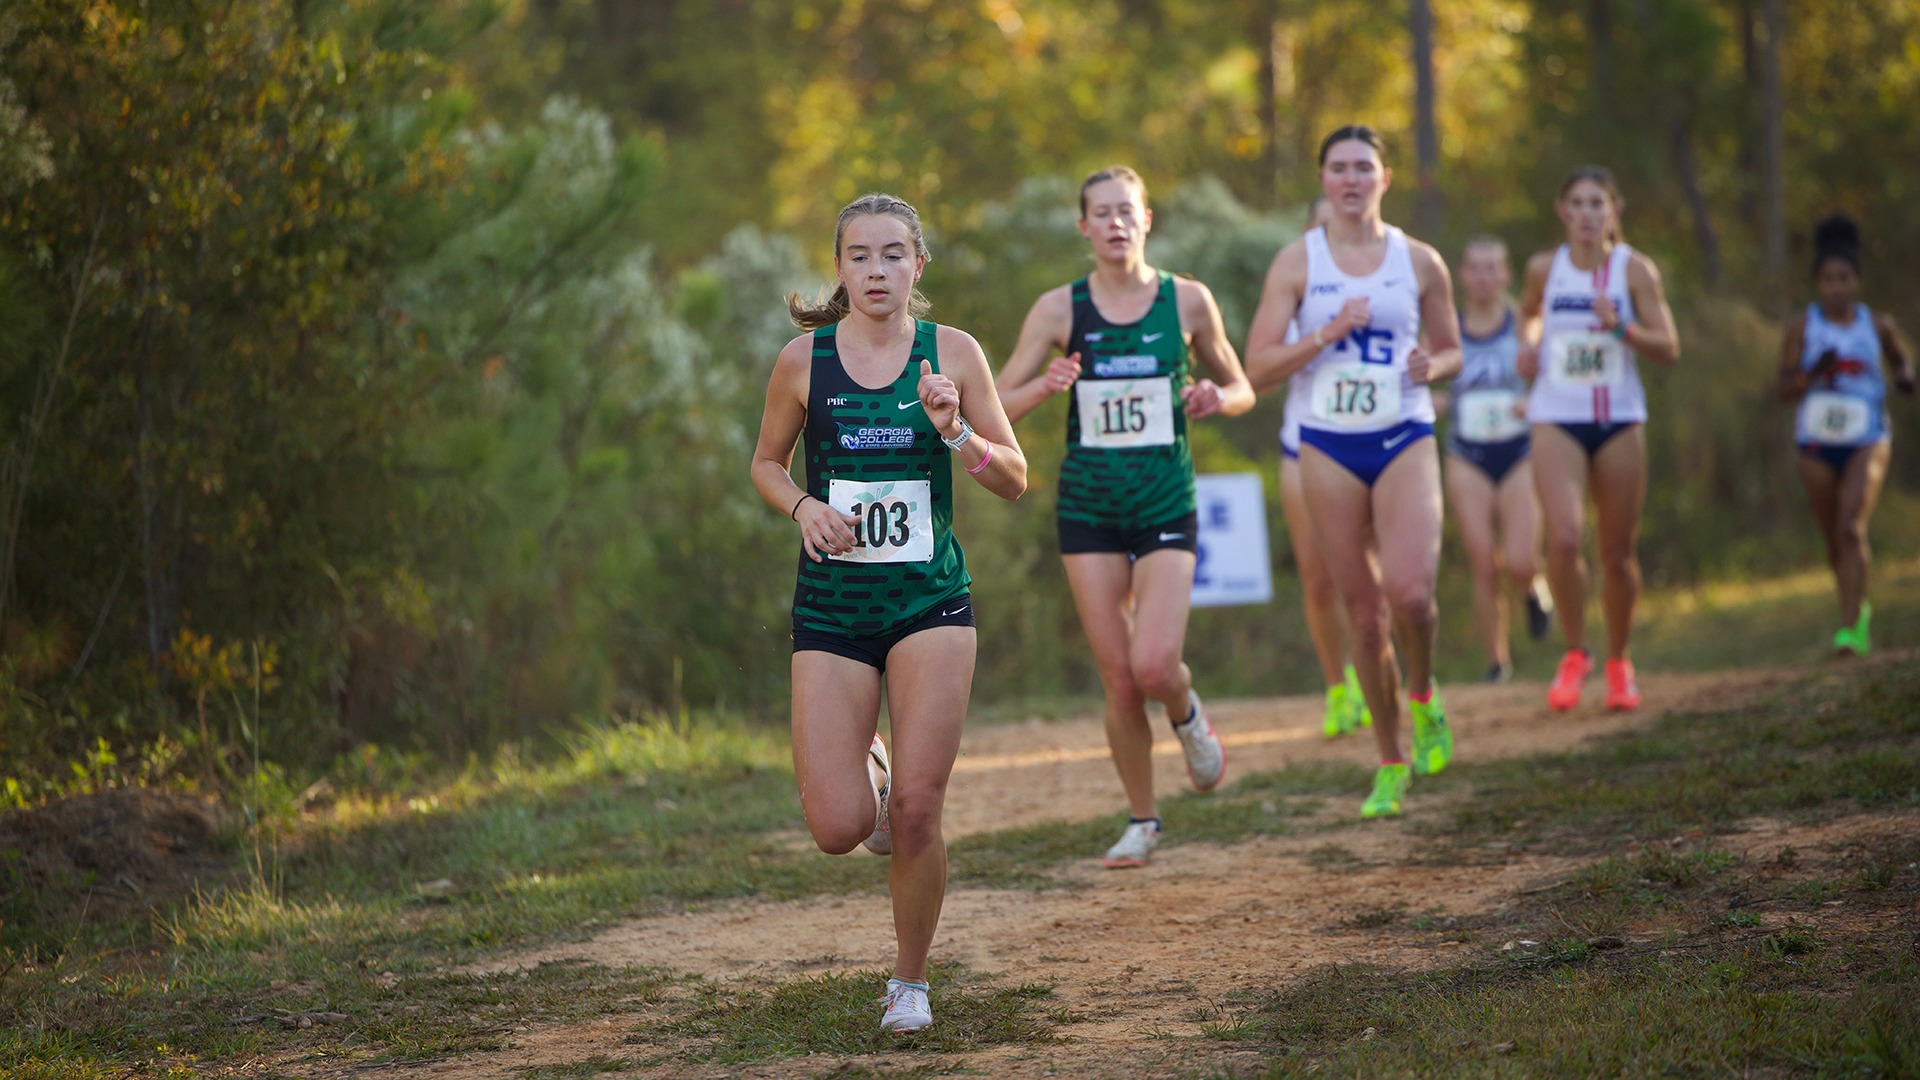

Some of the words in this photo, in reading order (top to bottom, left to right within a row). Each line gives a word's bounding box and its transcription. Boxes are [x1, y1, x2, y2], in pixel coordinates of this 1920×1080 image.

[827, 397, 848, 406] PBC
[1334, 380, 1376, 414] 173
[1100, 397, 1146, 435] 115
[858, 428, 913, 436] GEORGIA
[859, 436, 913, 444] COLLEGE
[851, 501, 910, 548] 103
